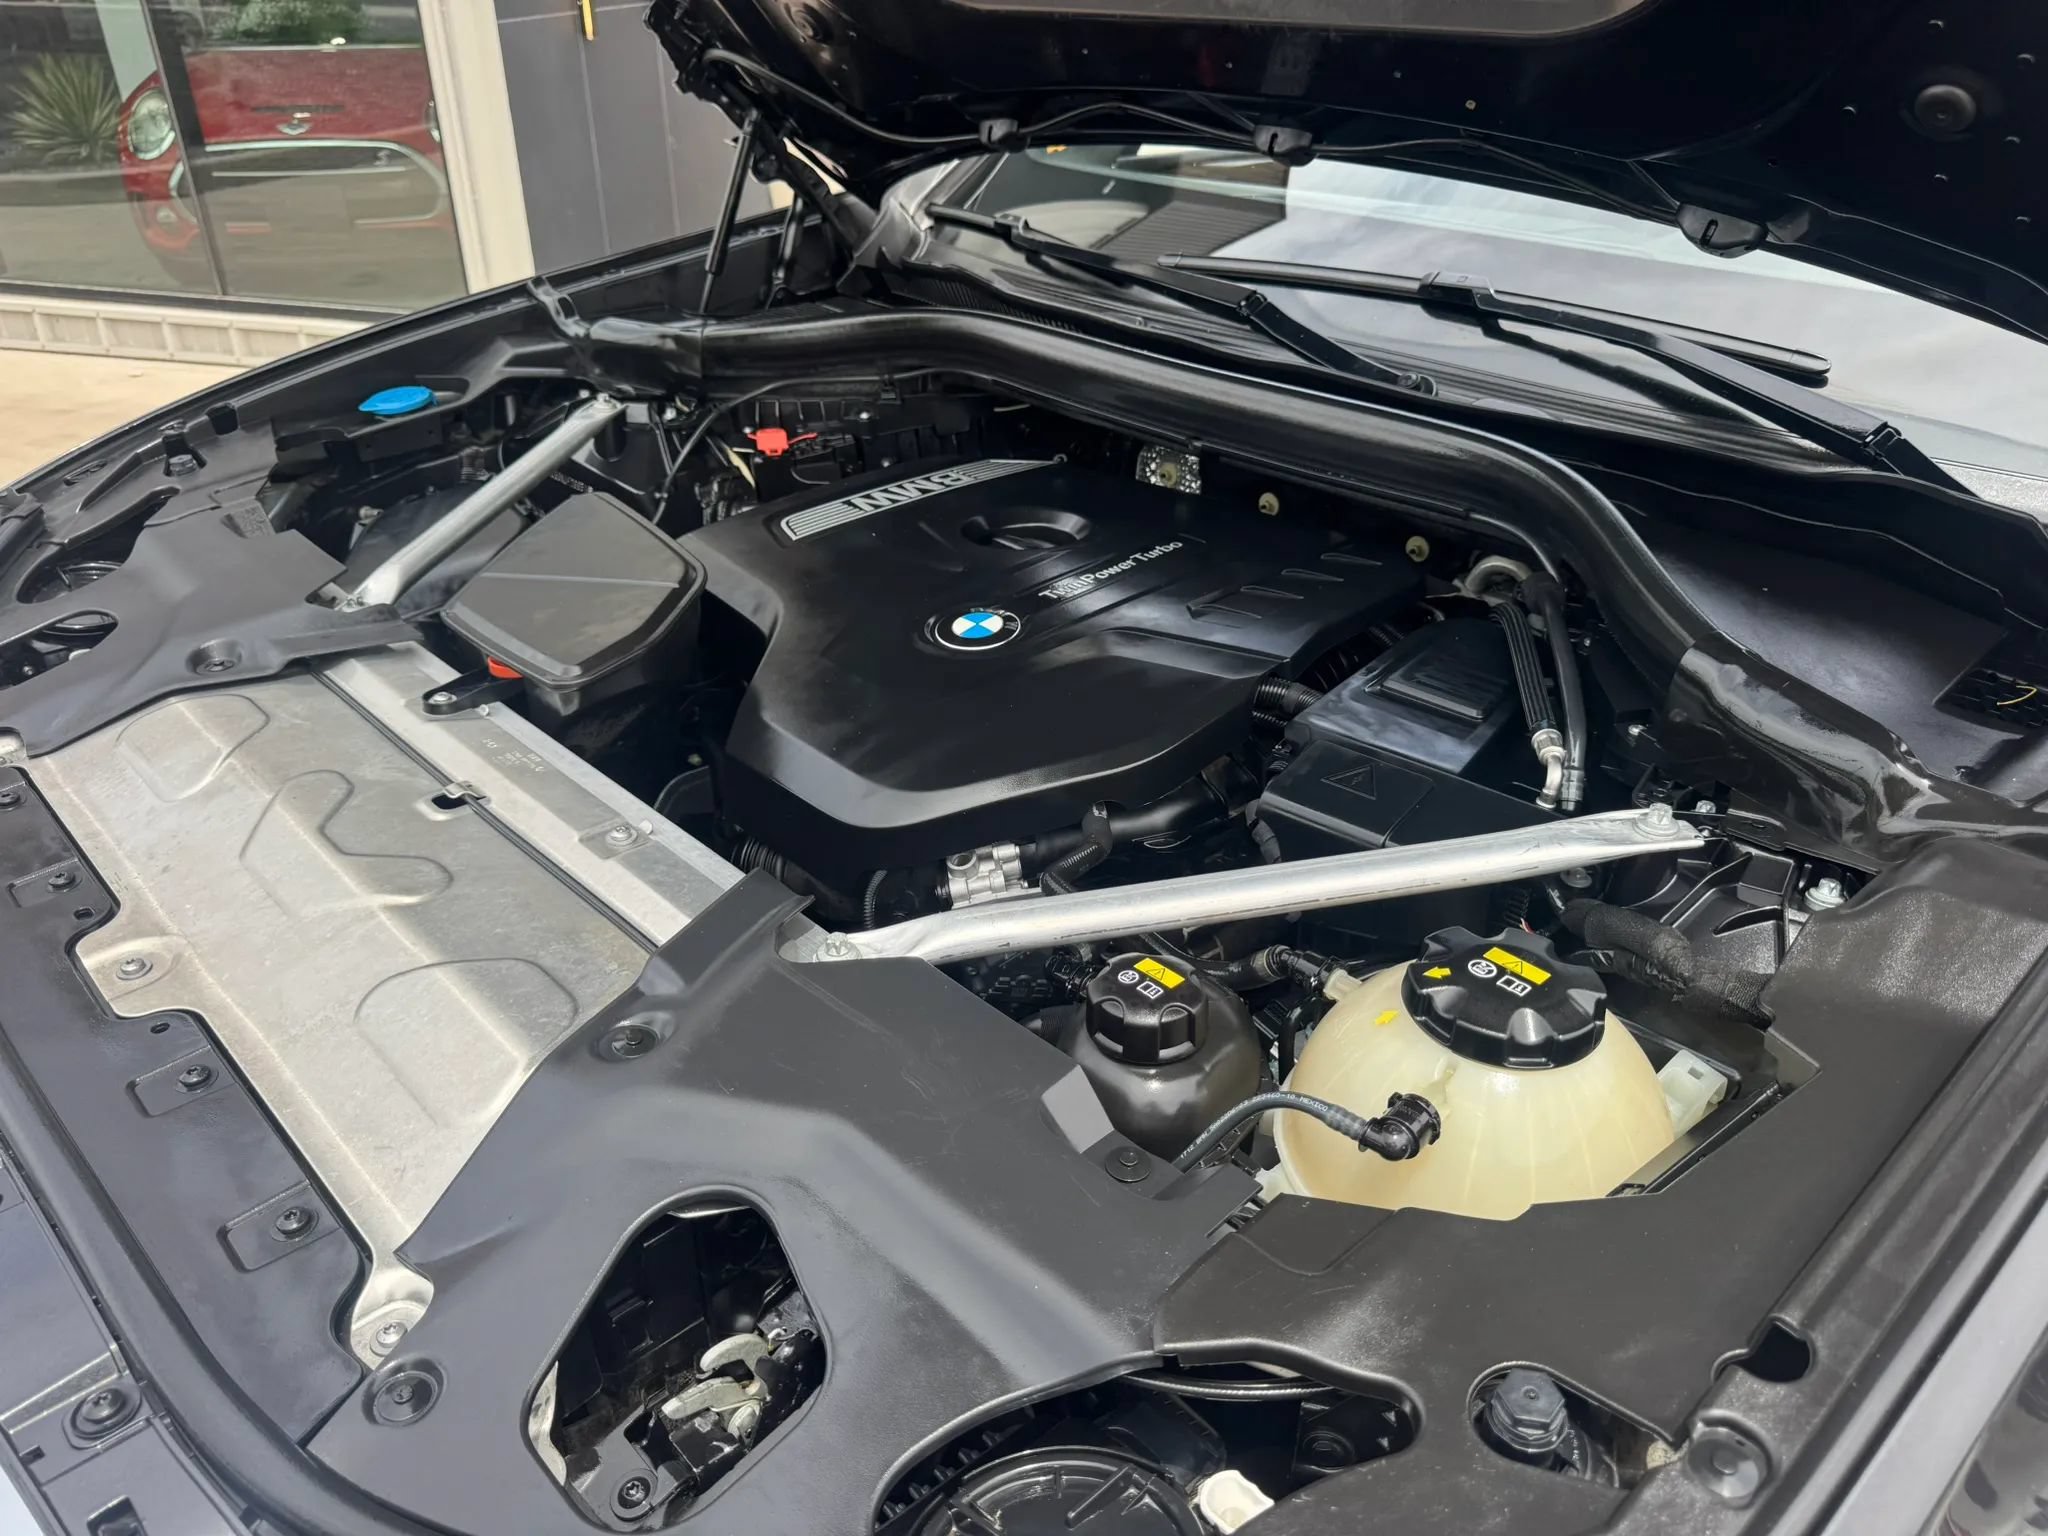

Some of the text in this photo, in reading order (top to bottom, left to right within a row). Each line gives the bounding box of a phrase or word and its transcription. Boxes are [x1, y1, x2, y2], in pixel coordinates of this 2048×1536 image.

[855, 470, 973, 512] BMW
[1038, 540, 1183, 599] TwinPowerTurbo
[1299, 1095, 1329, 1112] MEXICO
